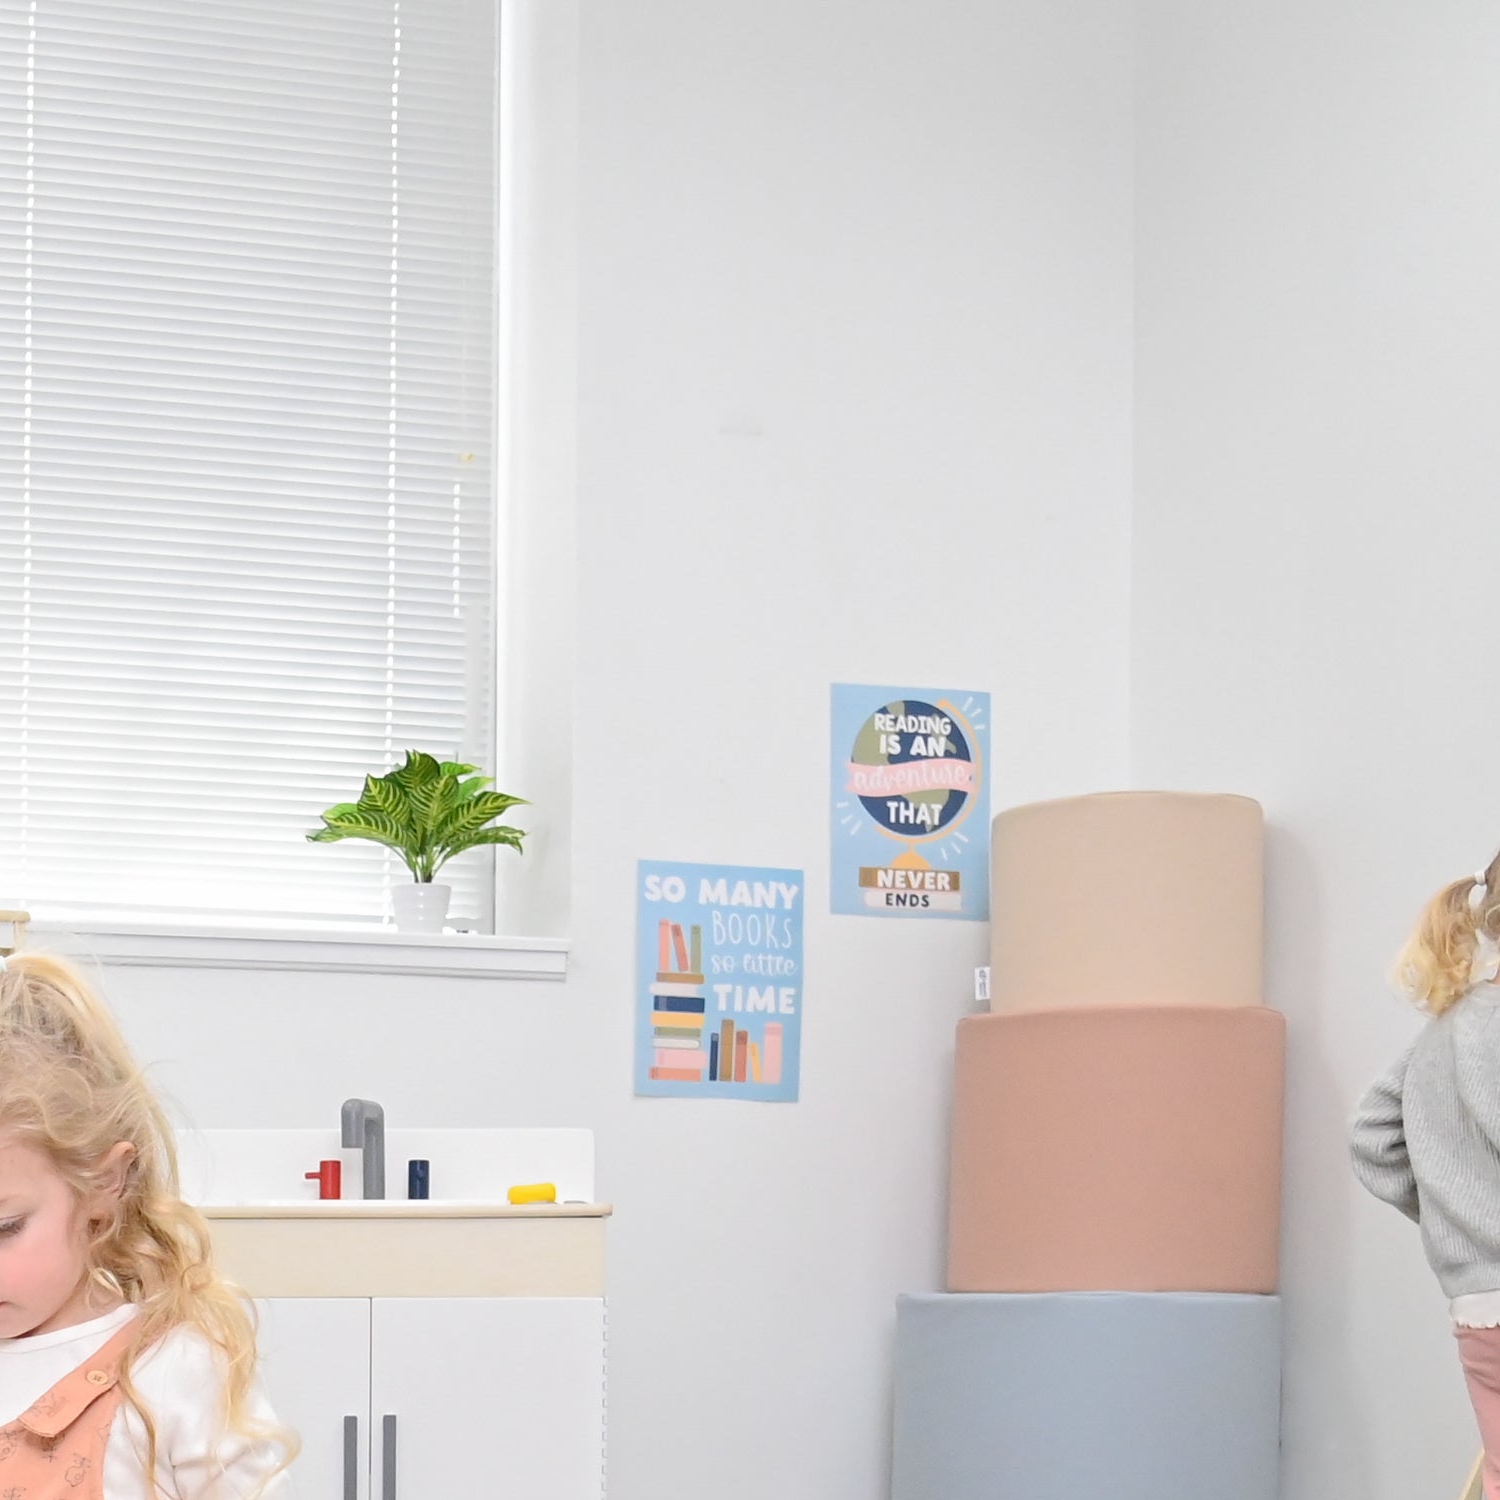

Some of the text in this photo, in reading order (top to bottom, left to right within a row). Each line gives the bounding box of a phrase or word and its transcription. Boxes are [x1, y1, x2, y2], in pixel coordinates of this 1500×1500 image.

[874, 713, 952, 735] READING
[879, 734, 946, 757] IS AN
[853, 762, 965, 791] adventure
[886, 801, 942, 825] THAT
[877, 869, 950, 890] NEVER
[644, 874, 798, 910] SO MANY
[885, 893, 930, 907] ENDS
[712, 910, 792, 949] BOOKS
[711, 952, 798, 976] so little
[713, 984, 796, 1014] TIME
